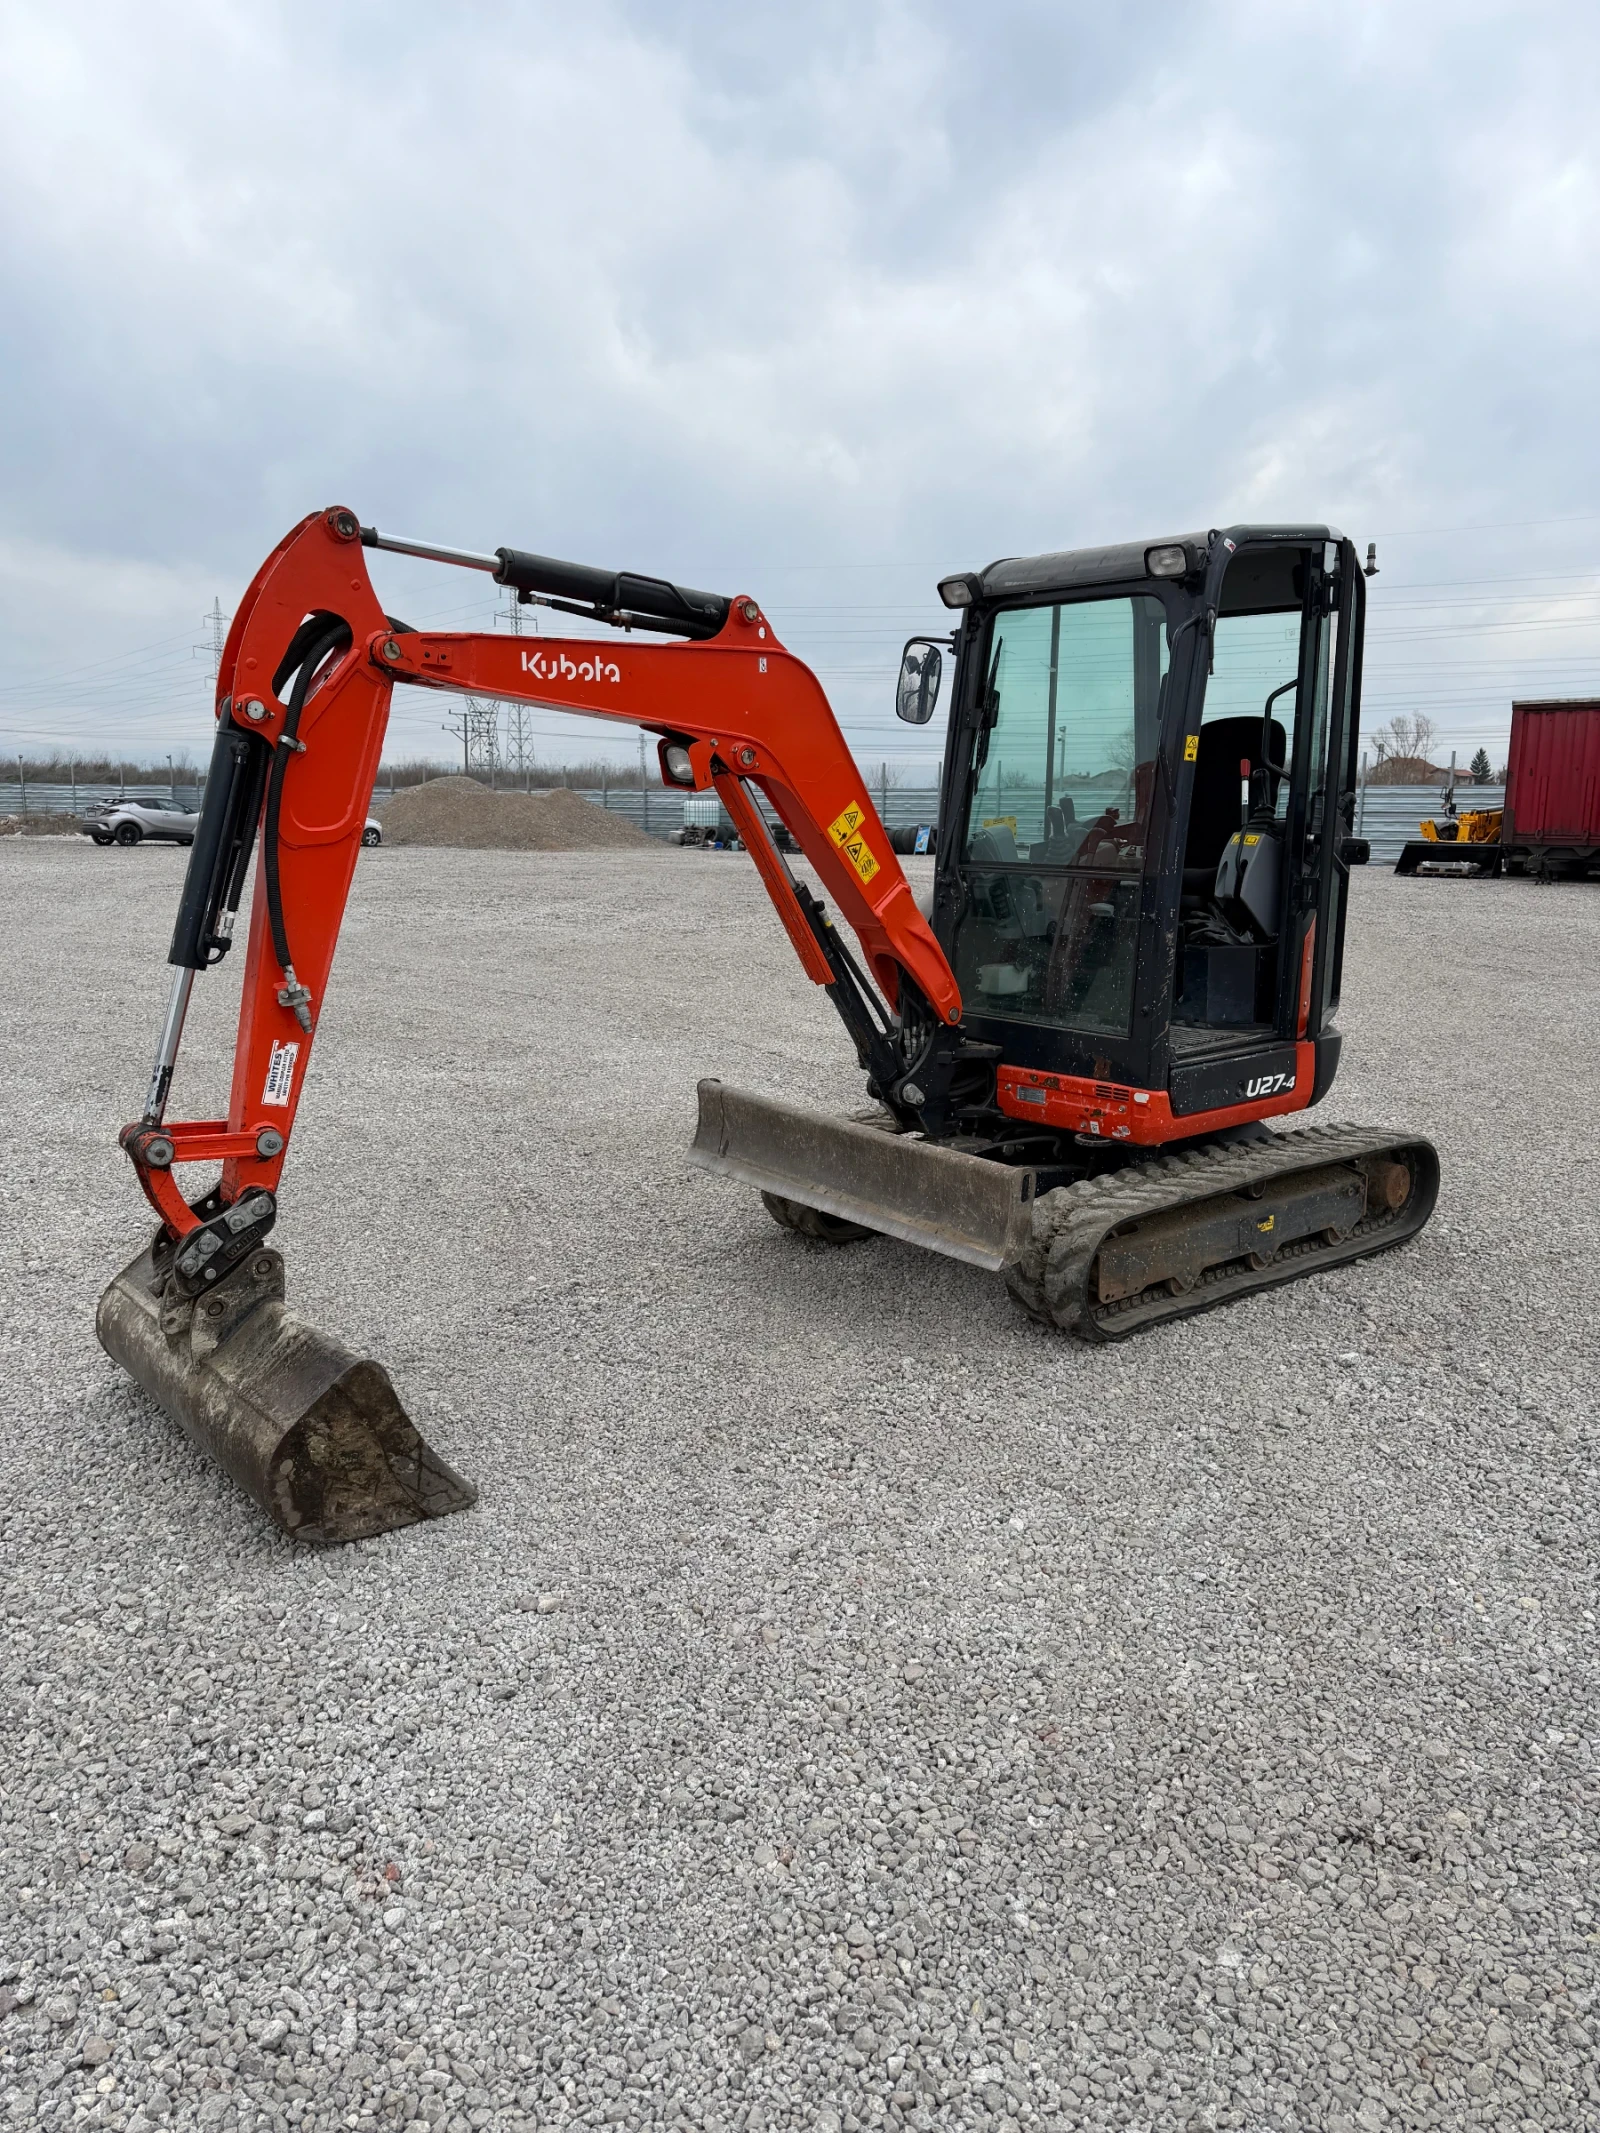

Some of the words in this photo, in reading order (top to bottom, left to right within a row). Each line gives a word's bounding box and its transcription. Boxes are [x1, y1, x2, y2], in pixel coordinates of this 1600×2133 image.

[521, 651, 620, 682] Kubota
[268, 1053, 283, 1092] WHITES
[1246, 1073, 1296, 1098] U27-4
[228, 1229, 260, 1256] WHITES
